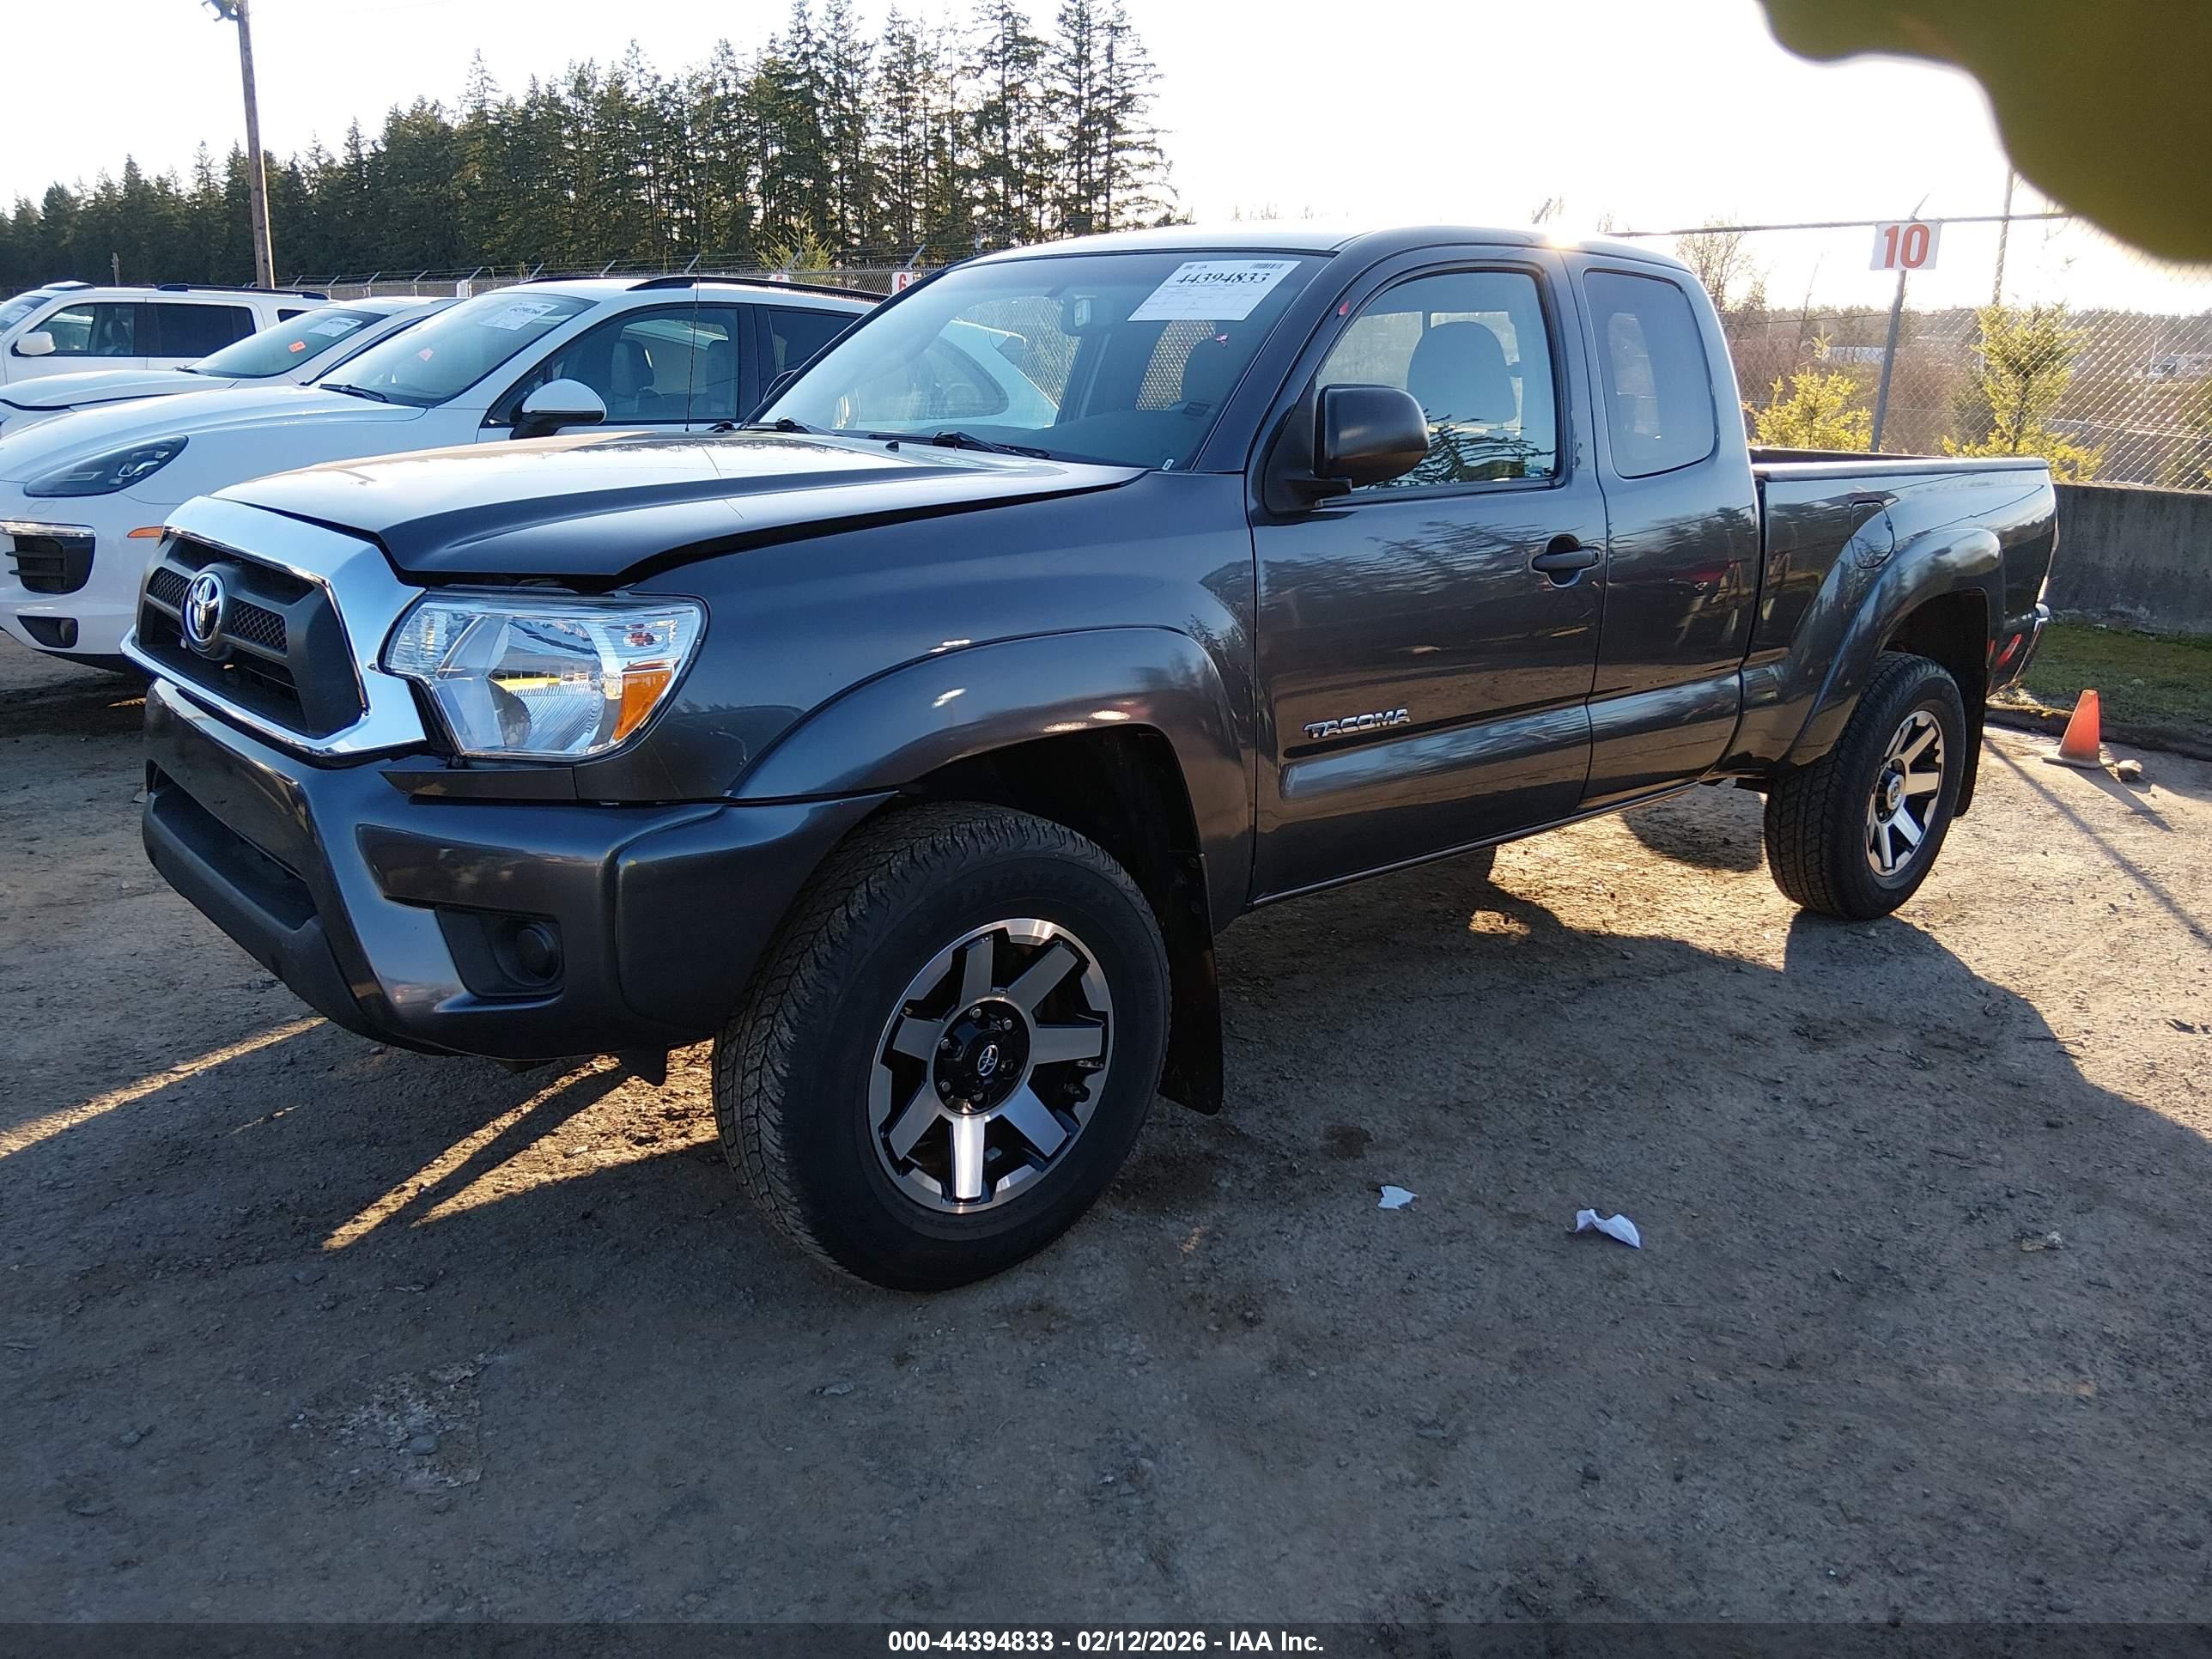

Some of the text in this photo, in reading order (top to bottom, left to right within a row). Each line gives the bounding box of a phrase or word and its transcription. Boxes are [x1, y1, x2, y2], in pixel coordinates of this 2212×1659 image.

[1883, 223, 1929, 269] 10
[1176, 271, 1271, 284] 44394833
[1304, 708, 1411, 738] TACOMA
